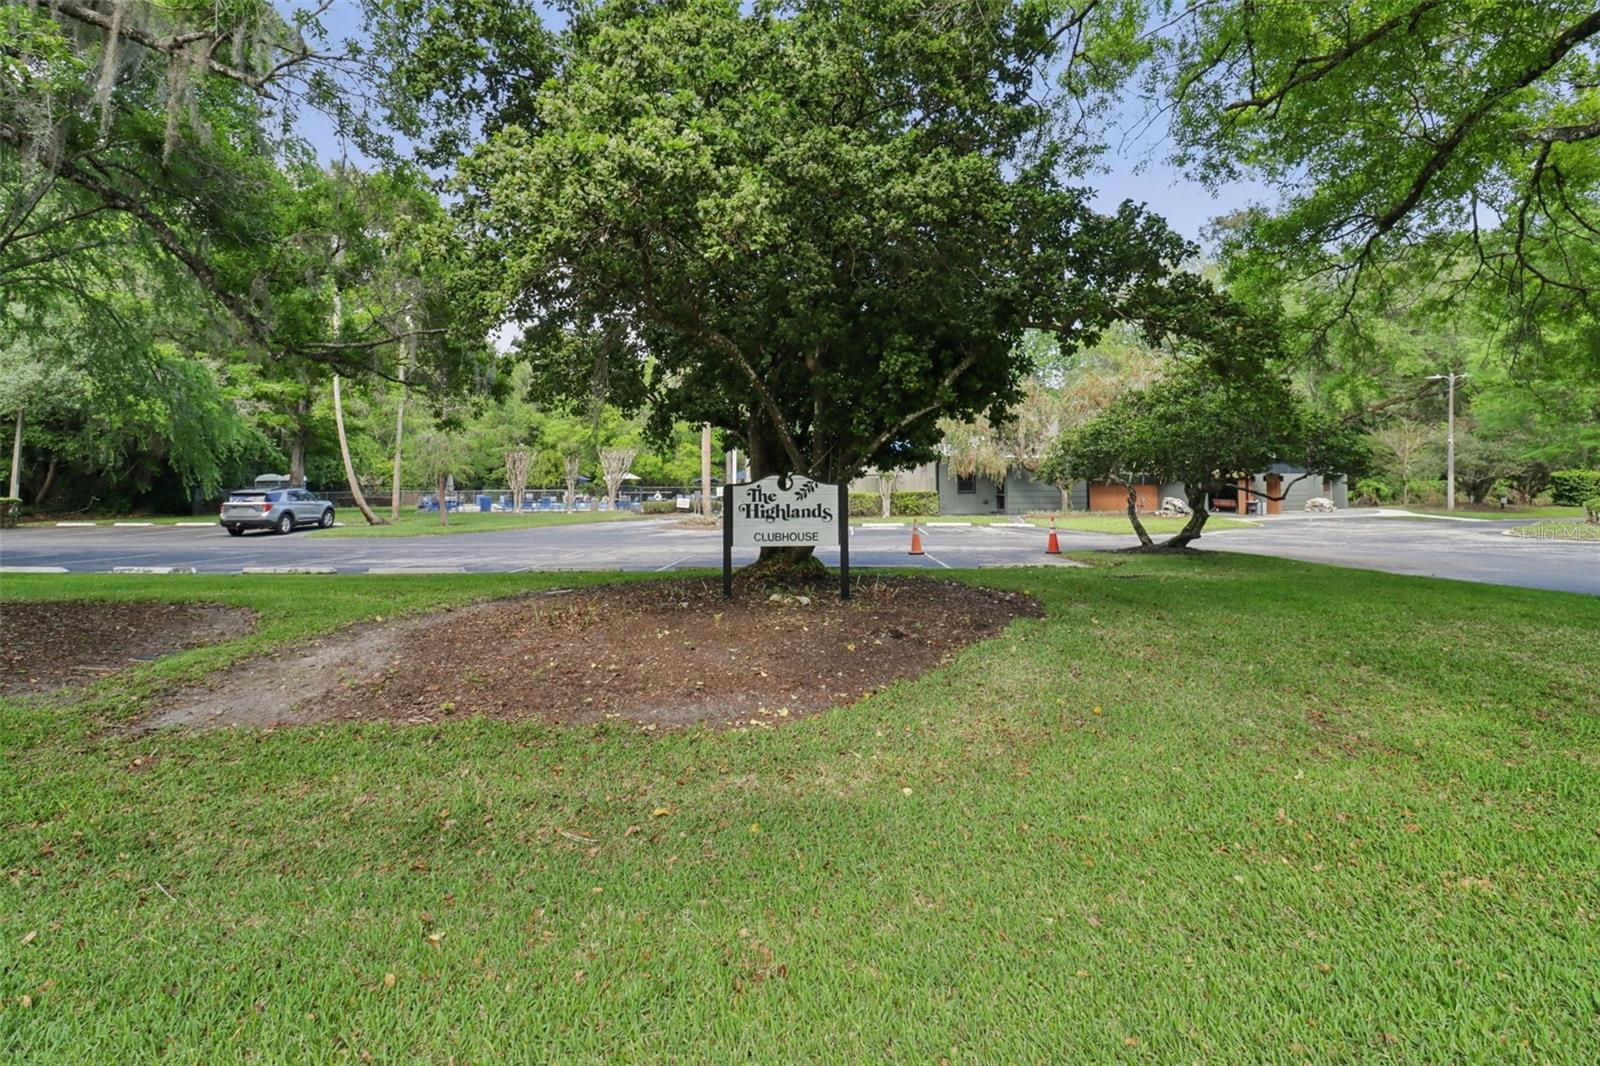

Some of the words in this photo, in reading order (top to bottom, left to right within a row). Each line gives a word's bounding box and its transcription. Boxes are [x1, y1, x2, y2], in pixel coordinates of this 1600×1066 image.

[747, 485, 777, 504] The
[738, 503, 833, 523] Highlands
[753, 532, 819, 542] CLUBHOUSE
